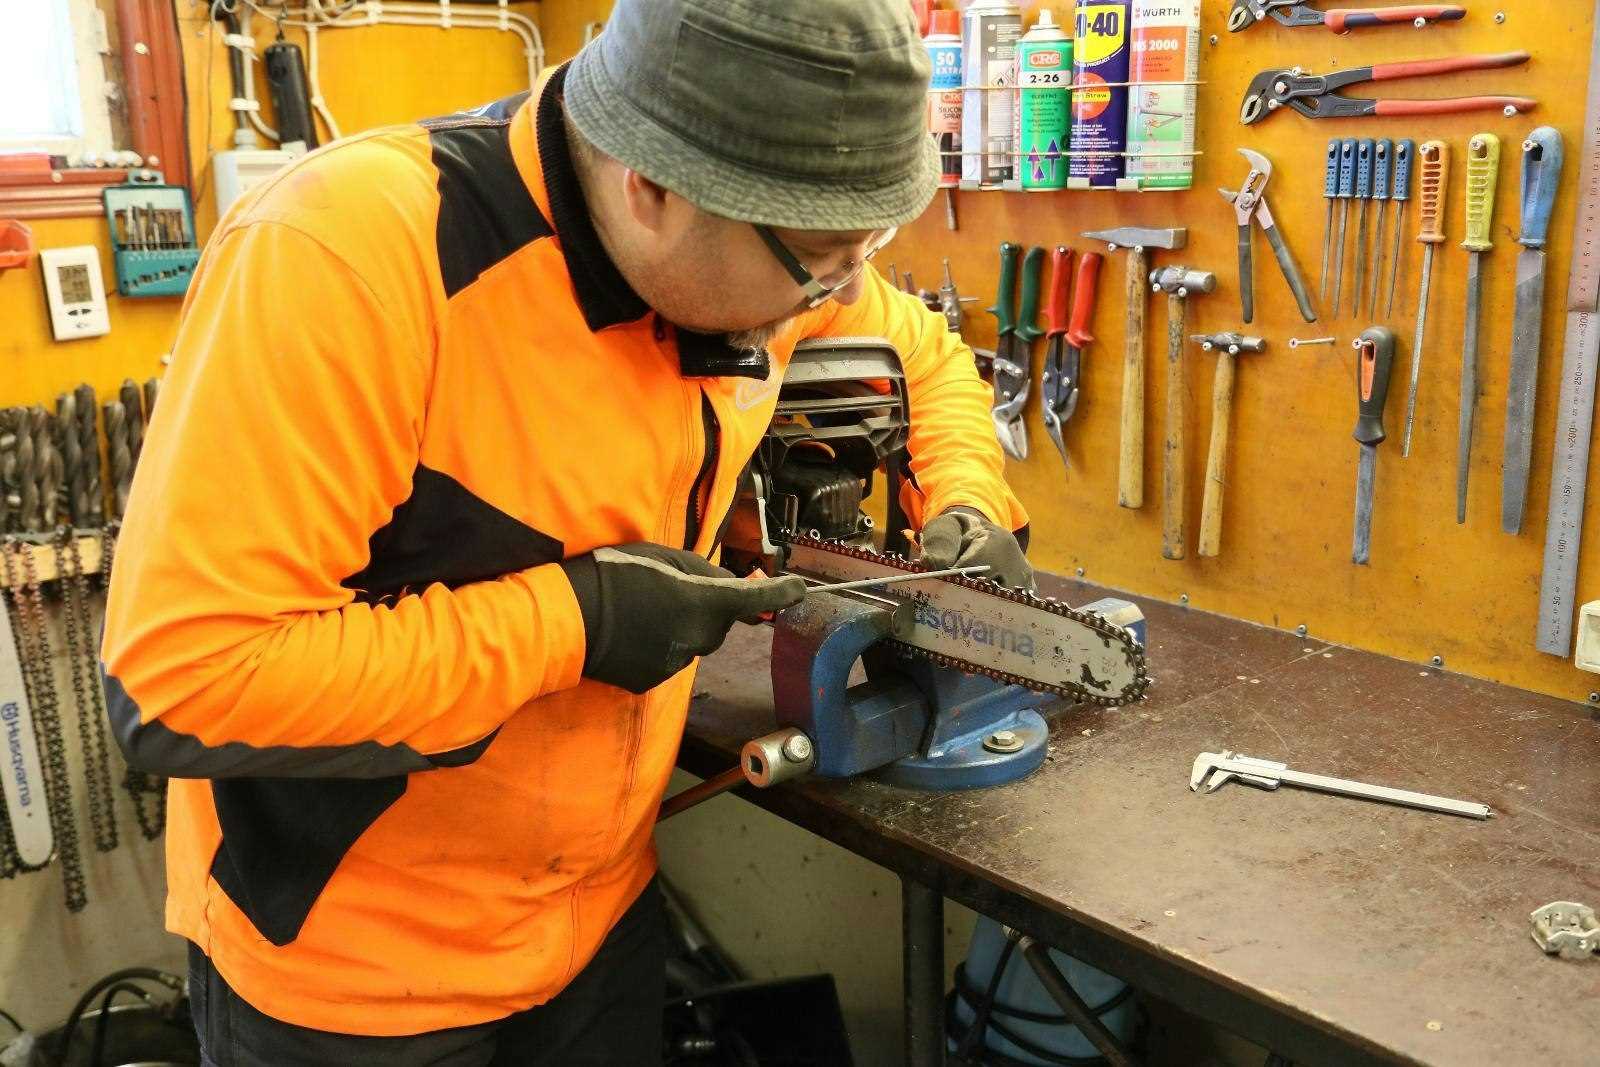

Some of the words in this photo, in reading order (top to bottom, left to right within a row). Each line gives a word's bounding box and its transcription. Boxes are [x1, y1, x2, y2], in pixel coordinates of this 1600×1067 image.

[1142, 8, 1181, 17] WÜRTH
[1075, 11, 1119, 38] D-40
[1149, 39, 1178, 51] 2000
[936, 51, 956, 66] 50
[1030, 74, 1060, 83] 2-26
[914, 605, 1034, 658] usqvarna
